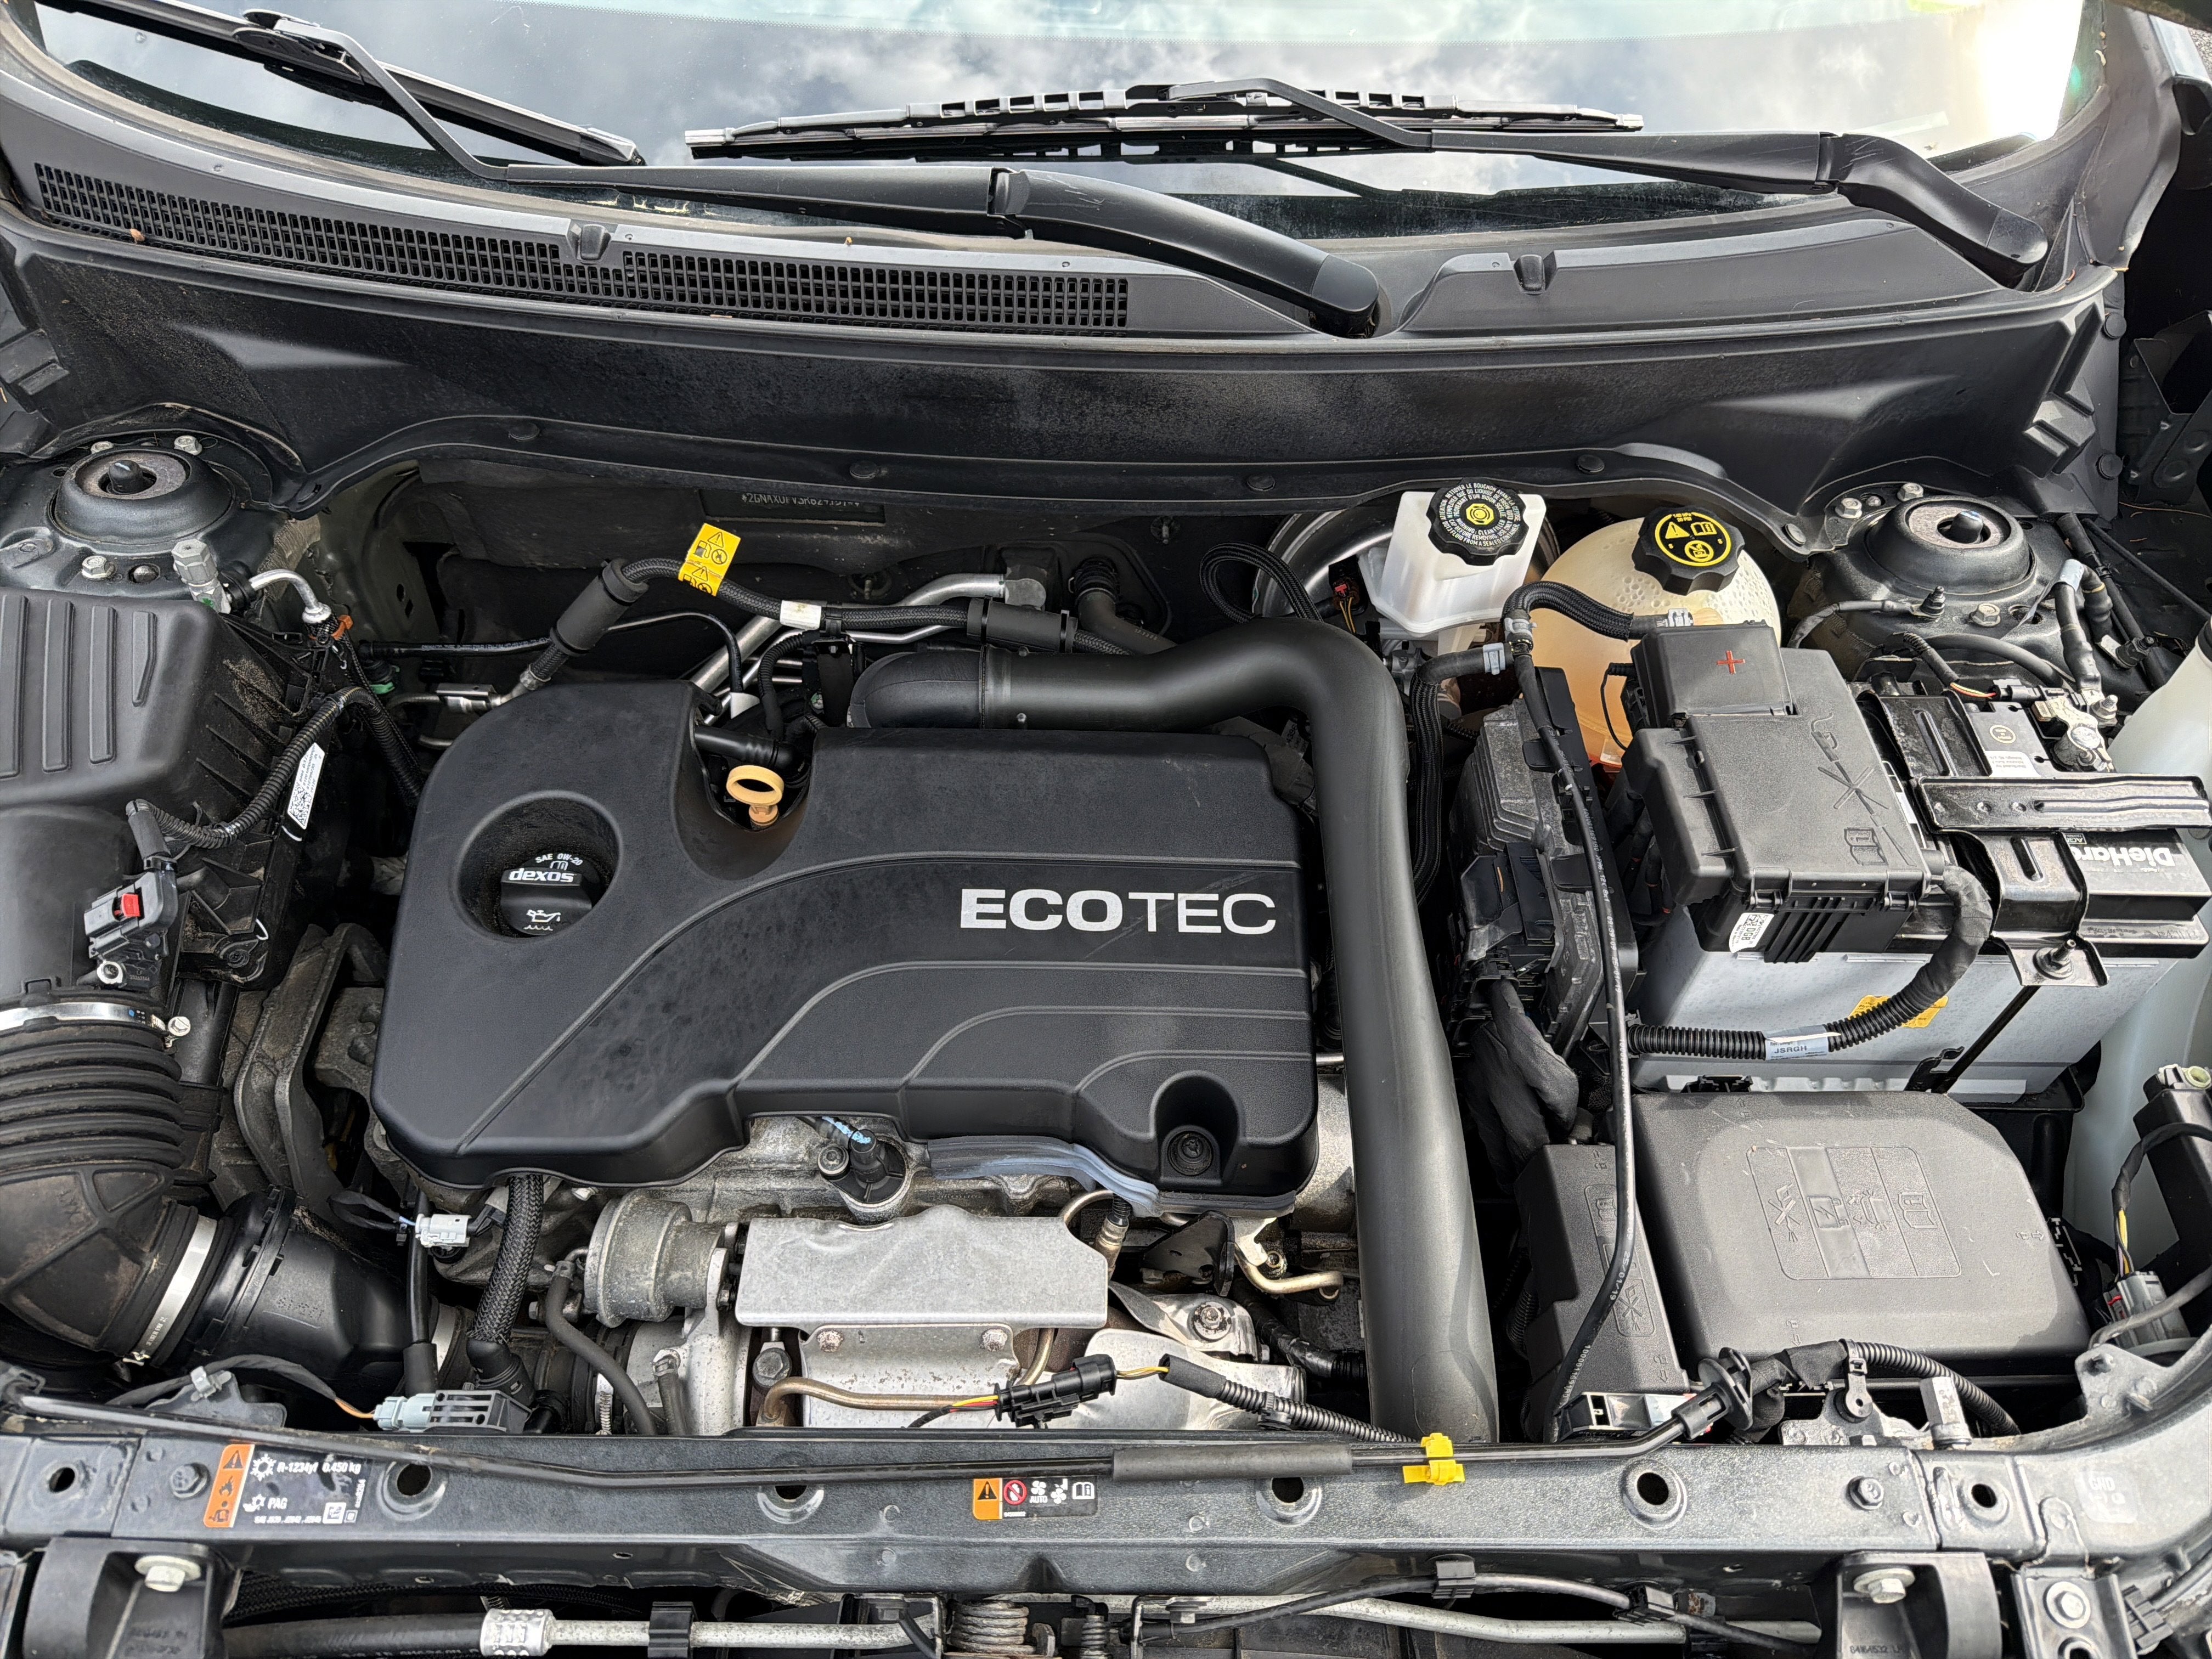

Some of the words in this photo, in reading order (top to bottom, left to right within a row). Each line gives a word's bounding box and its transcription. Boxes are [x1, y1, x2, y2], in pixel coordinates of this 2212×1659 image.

[1445, 484, 1466, 498] NETTOYER
[1473, 482, 1497, 492] BOUCHON
[1496, 489, 1511, 501] AVANT
[1474, 488, 1493, 496] LIQUIDE
[1481, 494, 1497, 504] BIDON
[1454, 526, 1472, 539] BEFORE
[1493, 520, 1506, 532] FILLER
[1451, 531, 1464, 541] FLUID
[534, 853, 553, 864] SAE
[557, 853, 583, 866] 0W-20
[509, 868, 573, 883] dexos
[960, 888, 1277, 935] ECOTEC
[1741, 928, 1757, 940] DGB
[1774, 1045, 1807, 1054] JSRGH
[1610, 1250, 1630, 1300] 25/01/19
[321, 1462, 348, 1473] 0.450
[348, 1462, 362, 1475] kg
[2089, 1477, 2115, 1491] GND
[267, 1497, 288, 1509] PAG
